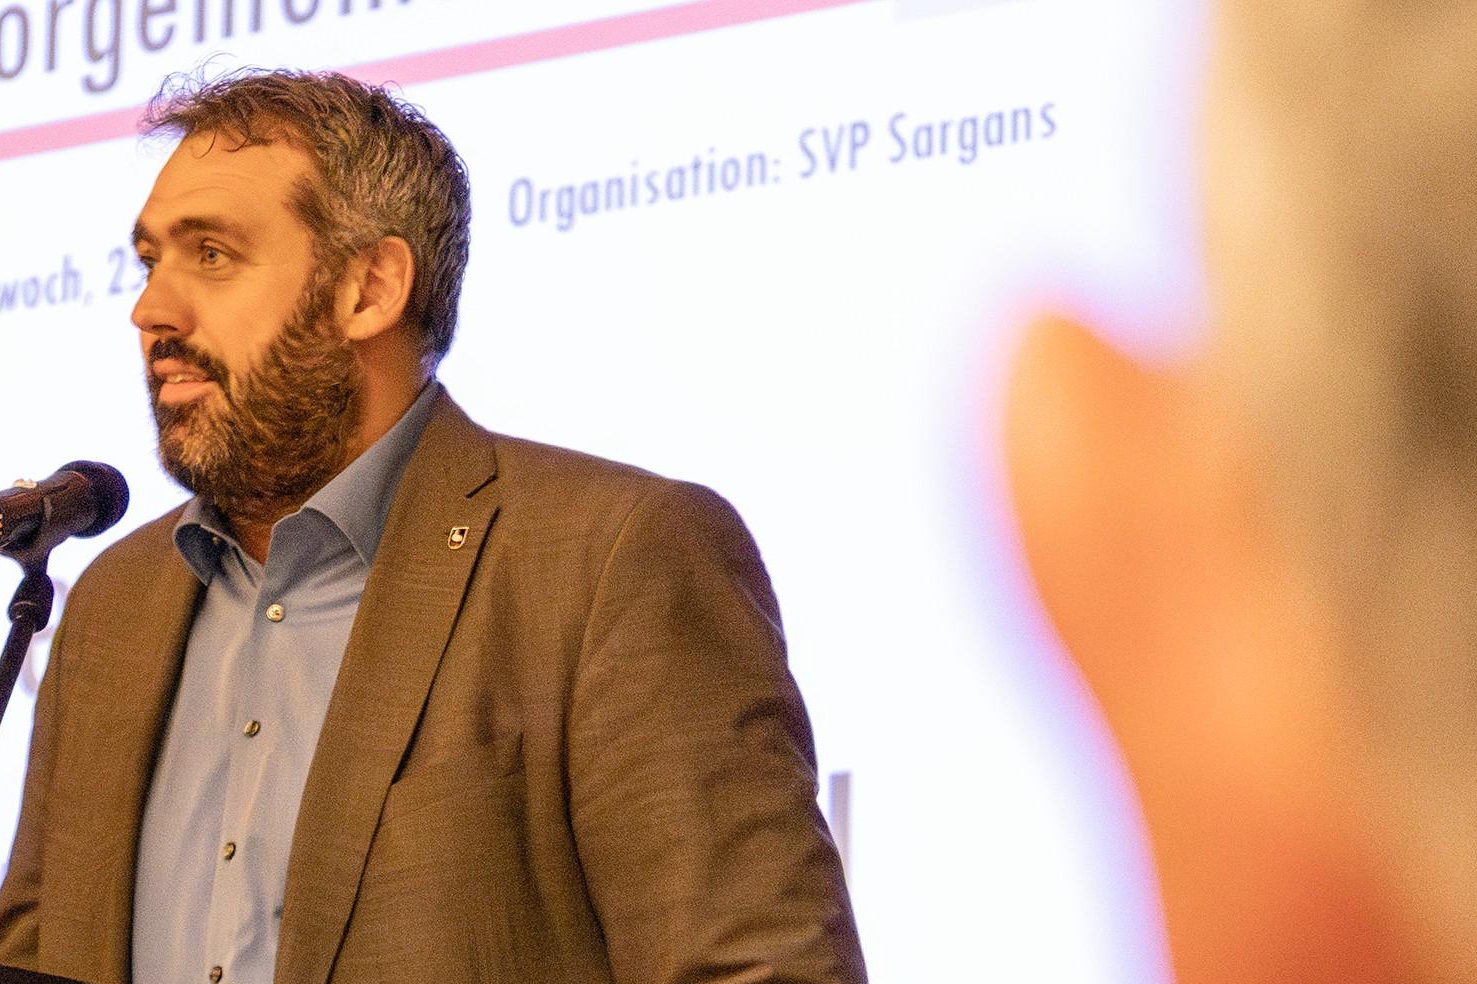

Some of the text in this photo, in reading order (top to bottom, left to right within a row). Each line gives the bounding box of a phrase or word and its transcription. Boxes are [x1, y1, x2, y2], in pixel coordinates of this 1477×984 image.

[508, 102, 1057, 232] Organisation: SVP Sargans
